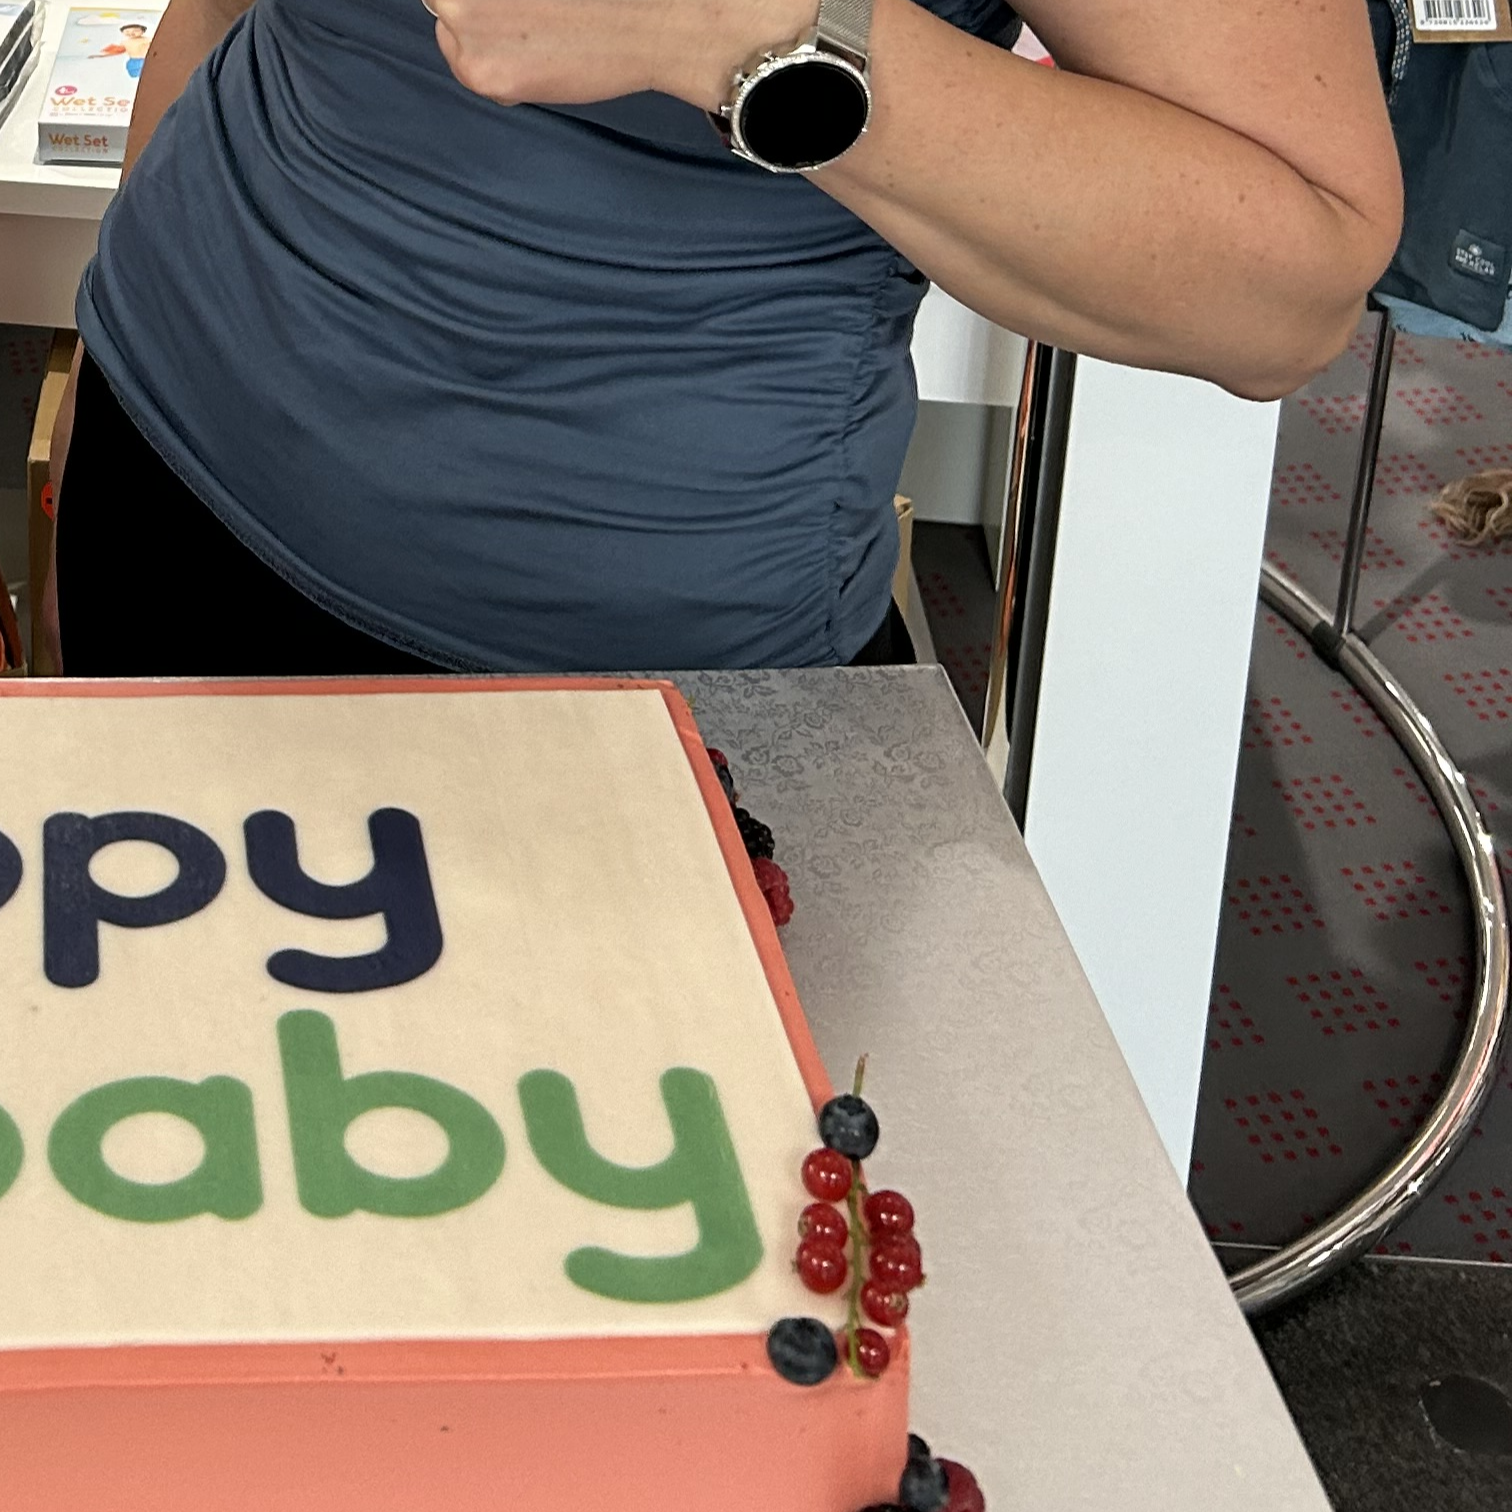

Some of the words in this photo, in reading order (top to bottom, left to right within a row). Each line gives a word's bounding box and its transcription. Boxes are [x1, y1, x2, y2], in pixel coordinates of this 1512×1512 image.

[50, 96, 97, 107] Wet
[102, 96, 131, 107] Se
[48, 133, 80, 146] Wet
[84, 134, 109, 148] Set
